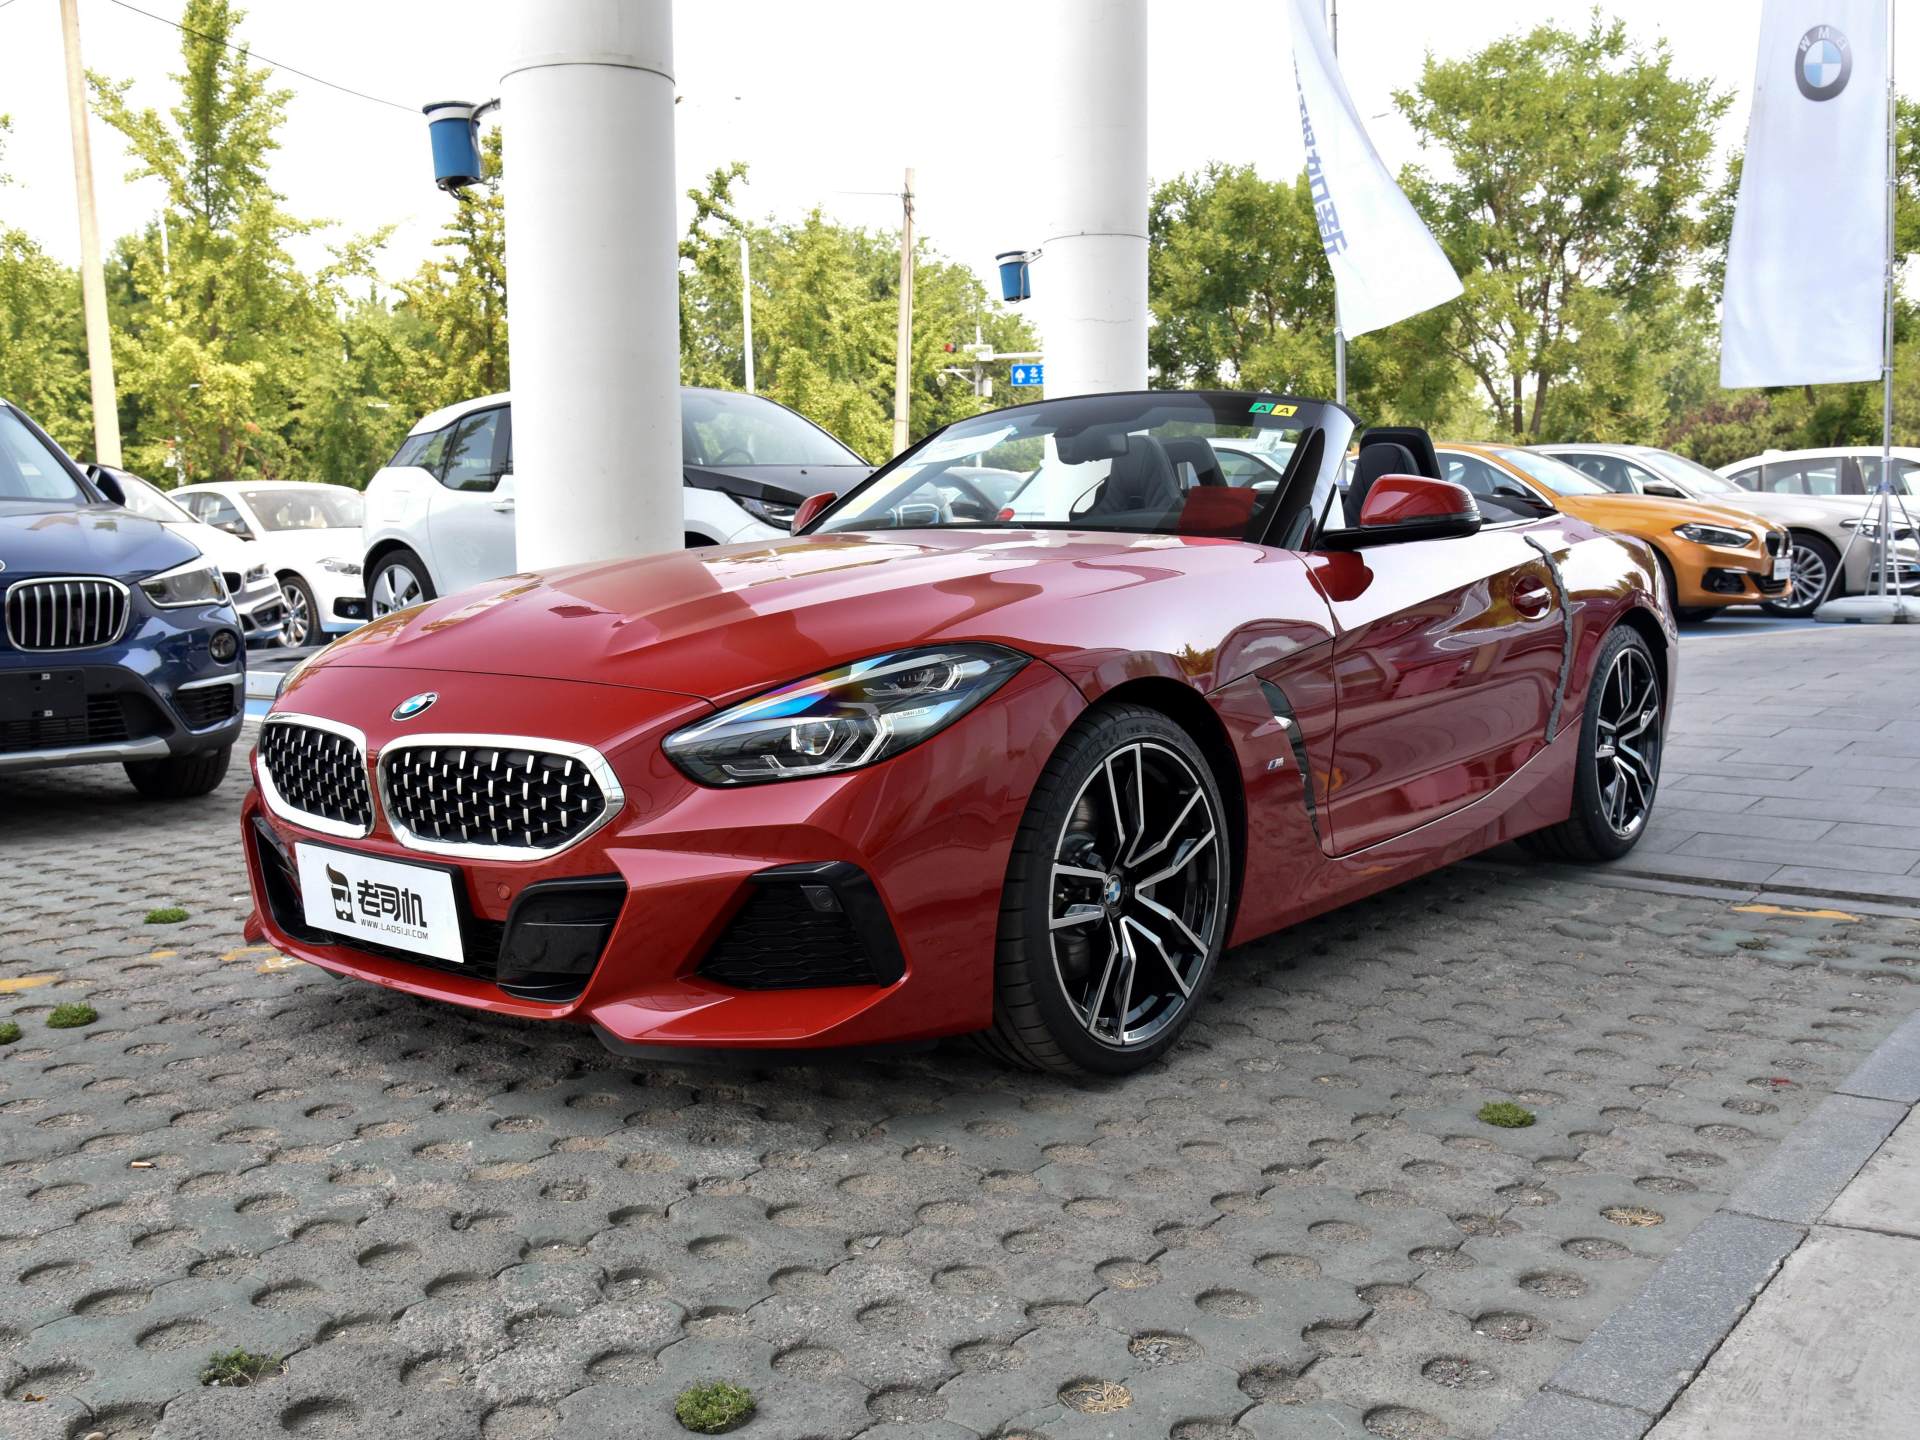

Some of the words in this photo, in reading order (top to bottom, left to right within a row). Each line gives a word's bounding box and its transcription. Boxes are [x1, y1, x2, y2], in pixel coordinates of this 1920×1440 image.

[357, 879, 428, 928] 老司机
[360, 918, 429, 940] WWW.LAOSIJI.COM
